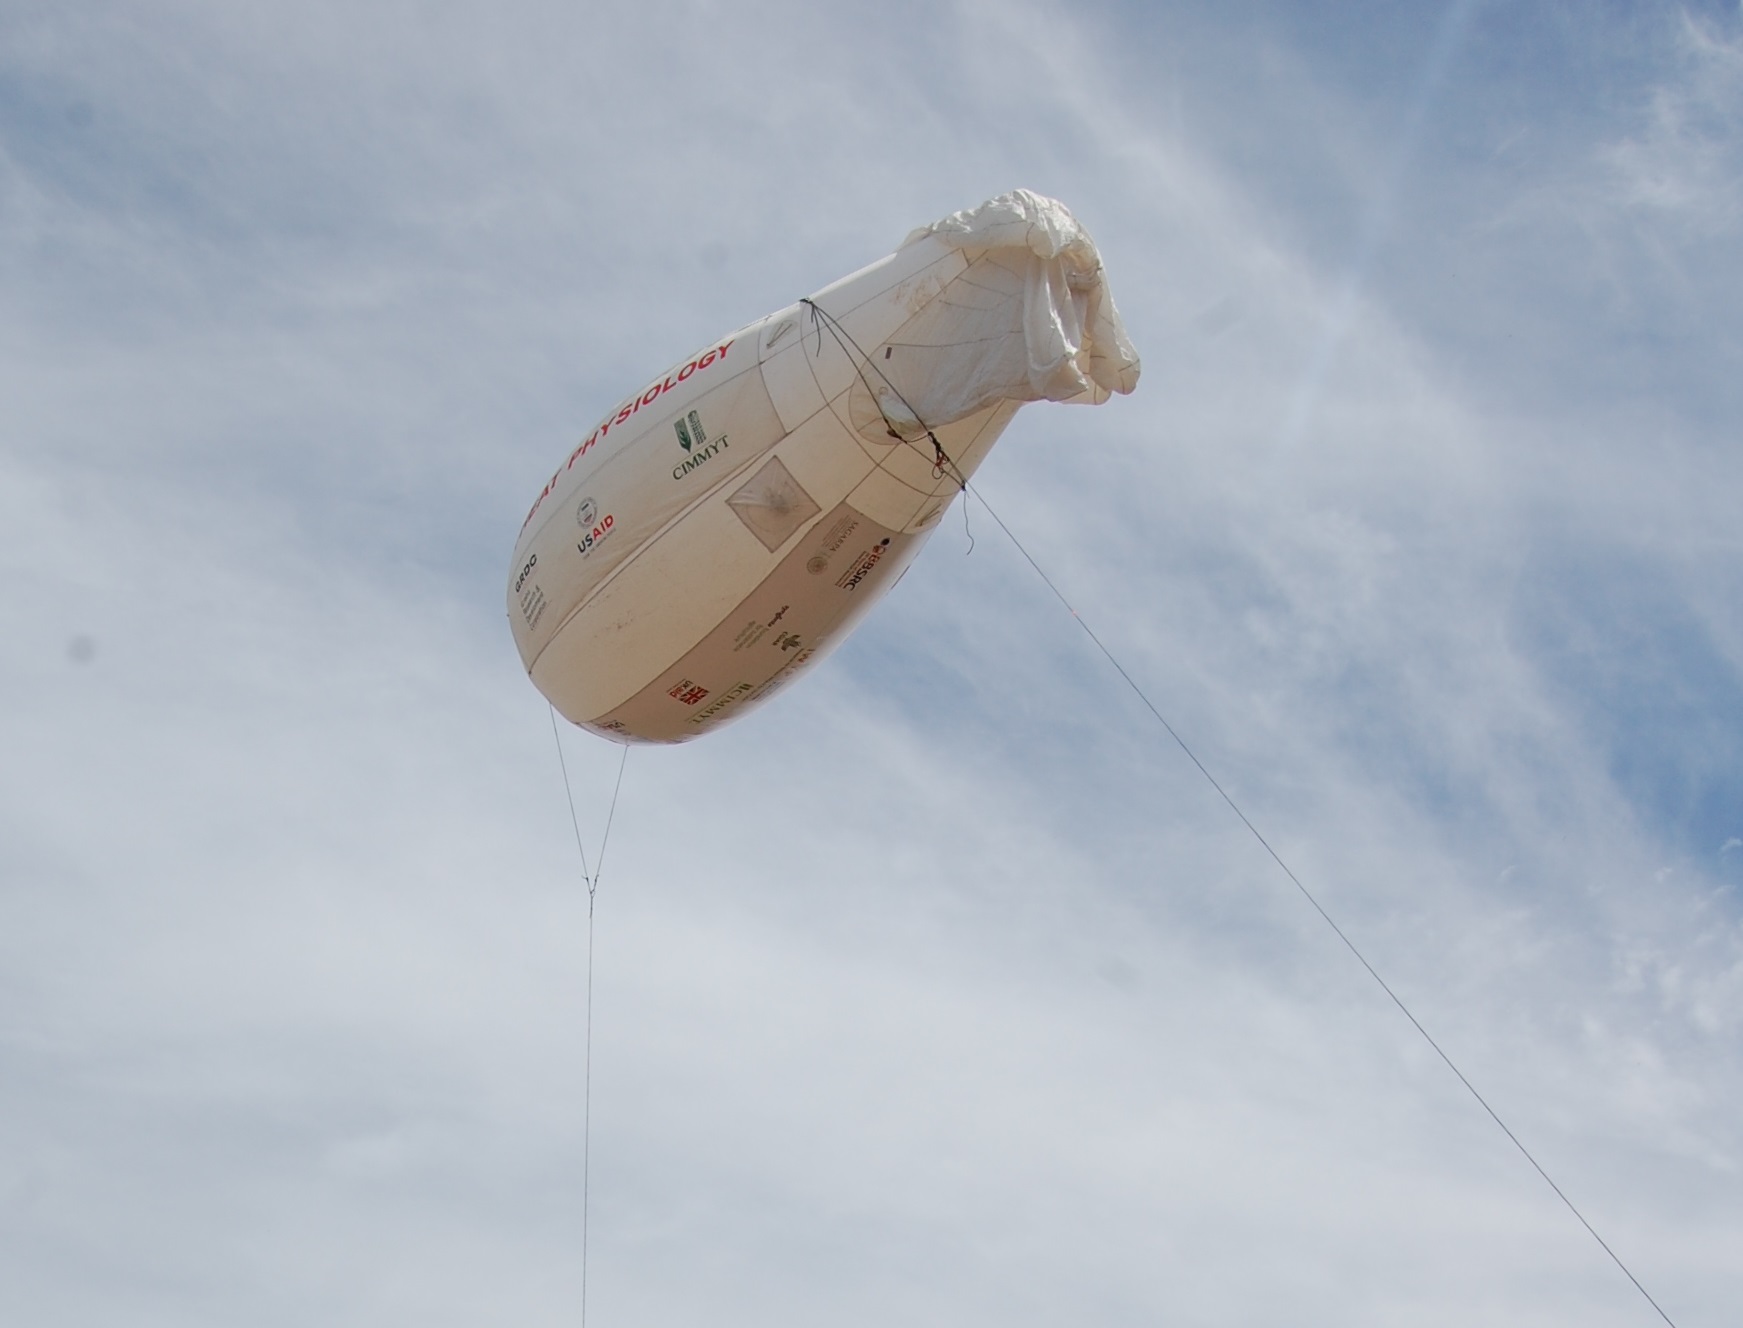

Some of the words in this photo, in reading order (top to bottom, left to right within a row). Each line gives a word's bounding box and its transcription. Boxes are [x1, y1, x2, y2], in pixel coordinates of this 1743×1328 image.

[567, 339, 736, 470] PHYSIOLOGY
[672, 434, 729, 480] CIMMYT
[577, 514, 614, 553] USAID
[829, 520, 859, 552] SAGARPA
[515, 553, 537, 592] GRDC
[842, 553, 881, 591] BBSRC
[690, 689, 743, 723] CIMMYT
